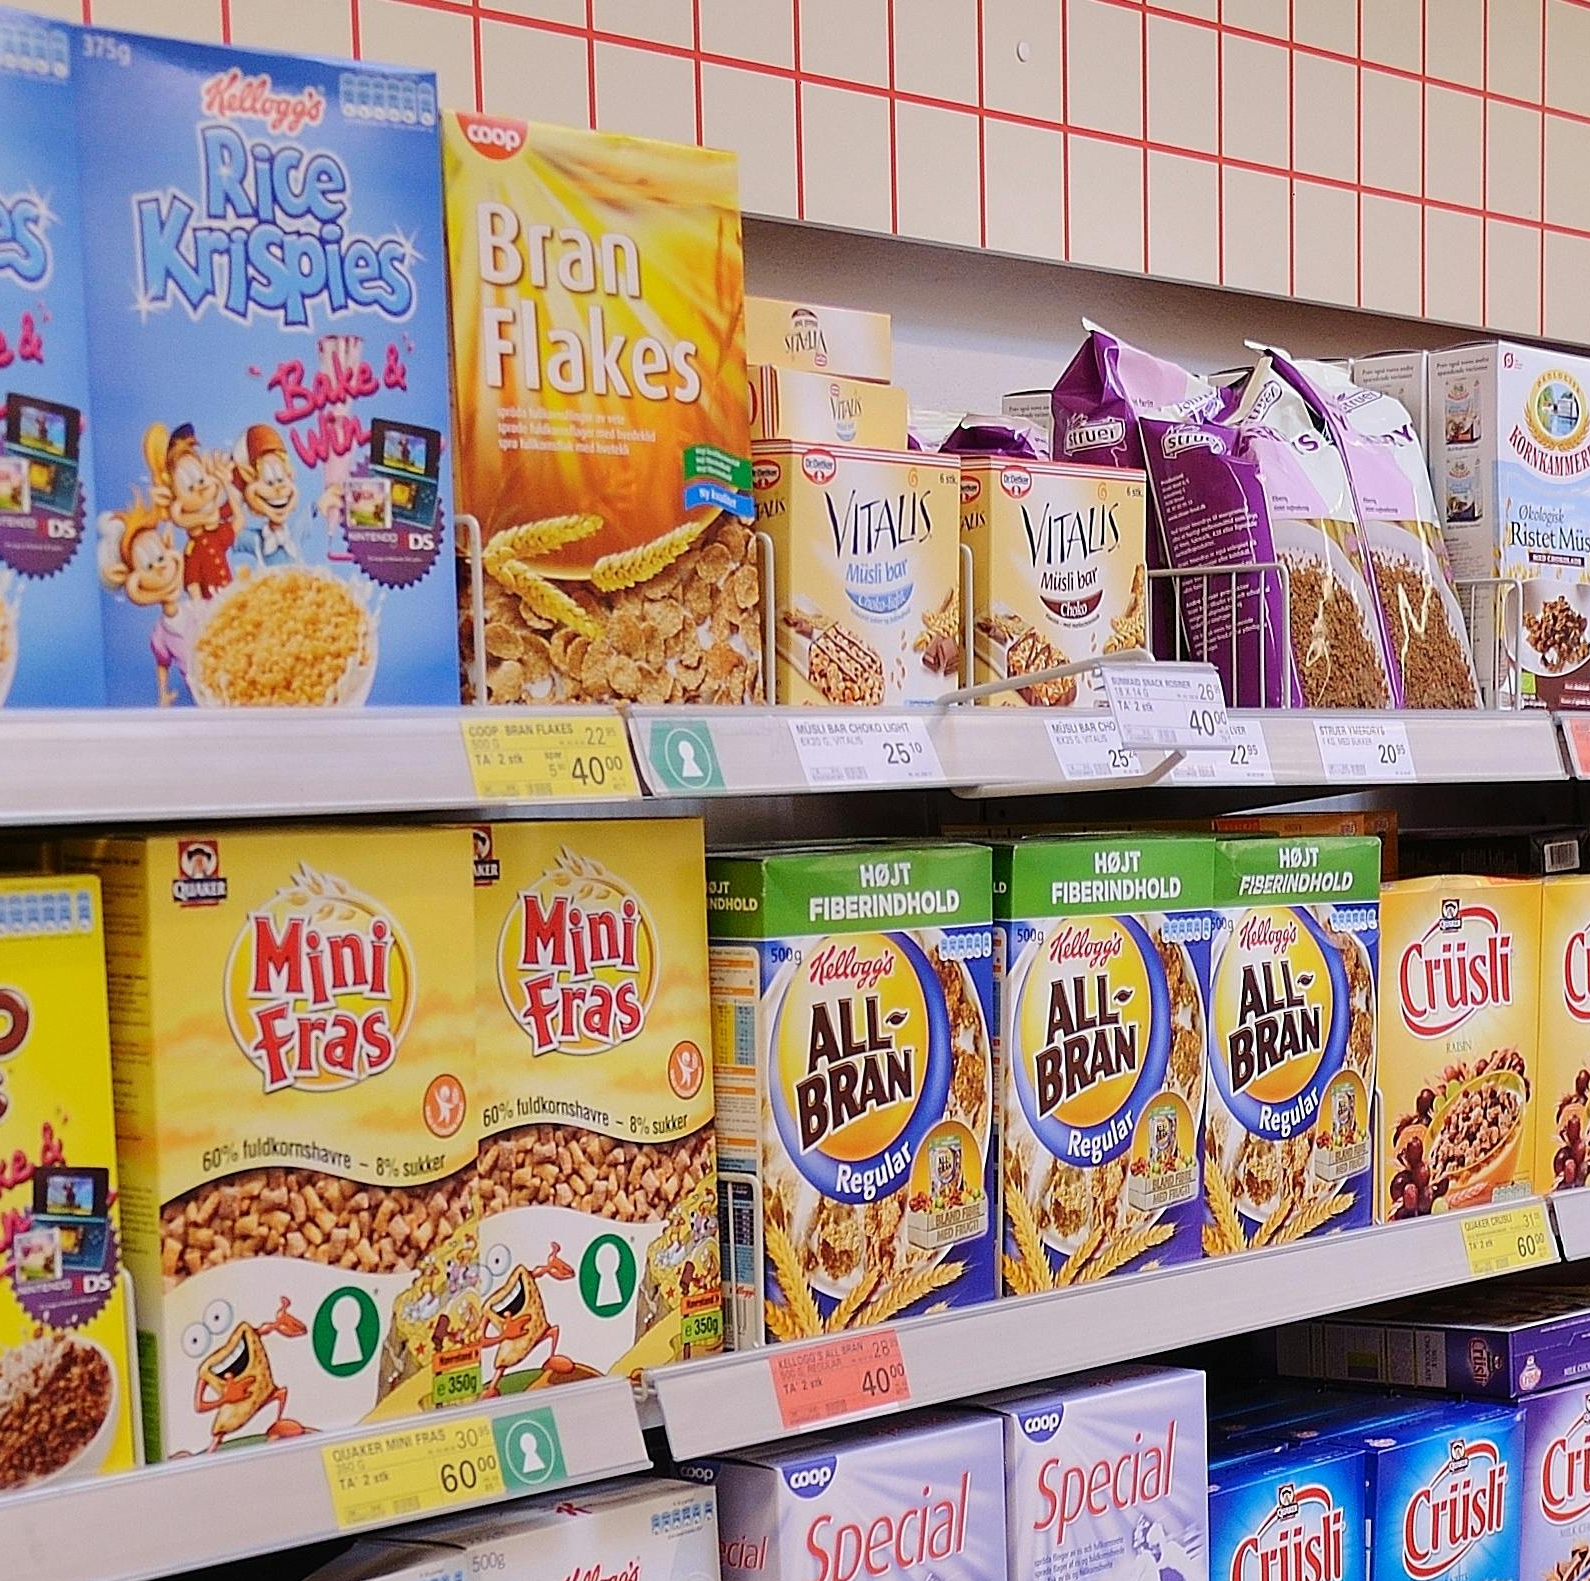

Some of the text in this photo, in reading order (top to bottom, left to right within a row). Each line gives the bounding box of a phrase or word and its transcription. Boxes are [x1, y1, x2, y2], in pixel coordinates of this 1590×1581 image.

[83, 35, 132, 68] 375g
[466, 122, 522, 154] coop
[204, 127, 347, 224] Rice
[140, 194, 414, 326] Krispies
[476, 202, 641, 302] Bran
[483, 312, 701, 403] Flakes
[824, 488, 933, 559] VITALIS
[1518, 504, 1565, 528] Økologisk
[1020, 502, 1121, 568] VITALIS
[1510, 520, 1557, 550] Ristet
[846, 558, 908, 583] Müsli bar
[1040, 566, 1099, 592] Müsli bar
[1059, 601, 1088, 619] Choko
[795, 721, 910, 735] MÜSLI BAR CHOKO LIGHT
[858, 861, 912, 890] HØJT
[1093, 851, 1141, 875] HØJT
[1277, 847, 1320, 869] HØJT
[173, 879, 228, 901] QUAKER
[1051, 876, 1182, 906] FIBERINDHOLD
[1238, 869, 1354, 896] FIBERINDHOLD
[809, 889, 961, 922] FIBERINDHOLD
[520, 896, 639, 971] Mini
[1016, 928, 1044, 946] 500g
[1049, 926, 1122, 962] Kellogg's
[1238, 917, 1297, 953] Kellogg's
[251, 914, 390, 1004] Mini
[770, 946, 802, 965] 500g
[809, 944, 894, 987] Kellogg's
[1399, 934, 1512, 1021] Crüsli
[1228, 1007, 1323, 1093] BRAN
[1036, 1024, 1137, 1119] BRAN
[483, 1096, 689, 1136] 60% fuldkornshavre 8% sukker
[795, 1053, 915, 1155] BRAN
[1258, 1088, 1320, 1133] Regular
[1066, 1110, 1135, 1160] Regular
[202, 1140, 446, 1179] 60% fuldkornshavre 8% sukker
[834, 1143, 914, 1199] Regular
[448, 1373, 478, 1399] 350g
[1023, 1410, 1062, 1435] coop
[332, 1429, 446, 1463] QUAKER MINI FRAS
[788, 1462, 831, 1489] coop
[1032, 1419, 1177, 1545] Special
[1402, 1460, 1508, 1561] Crüsli
